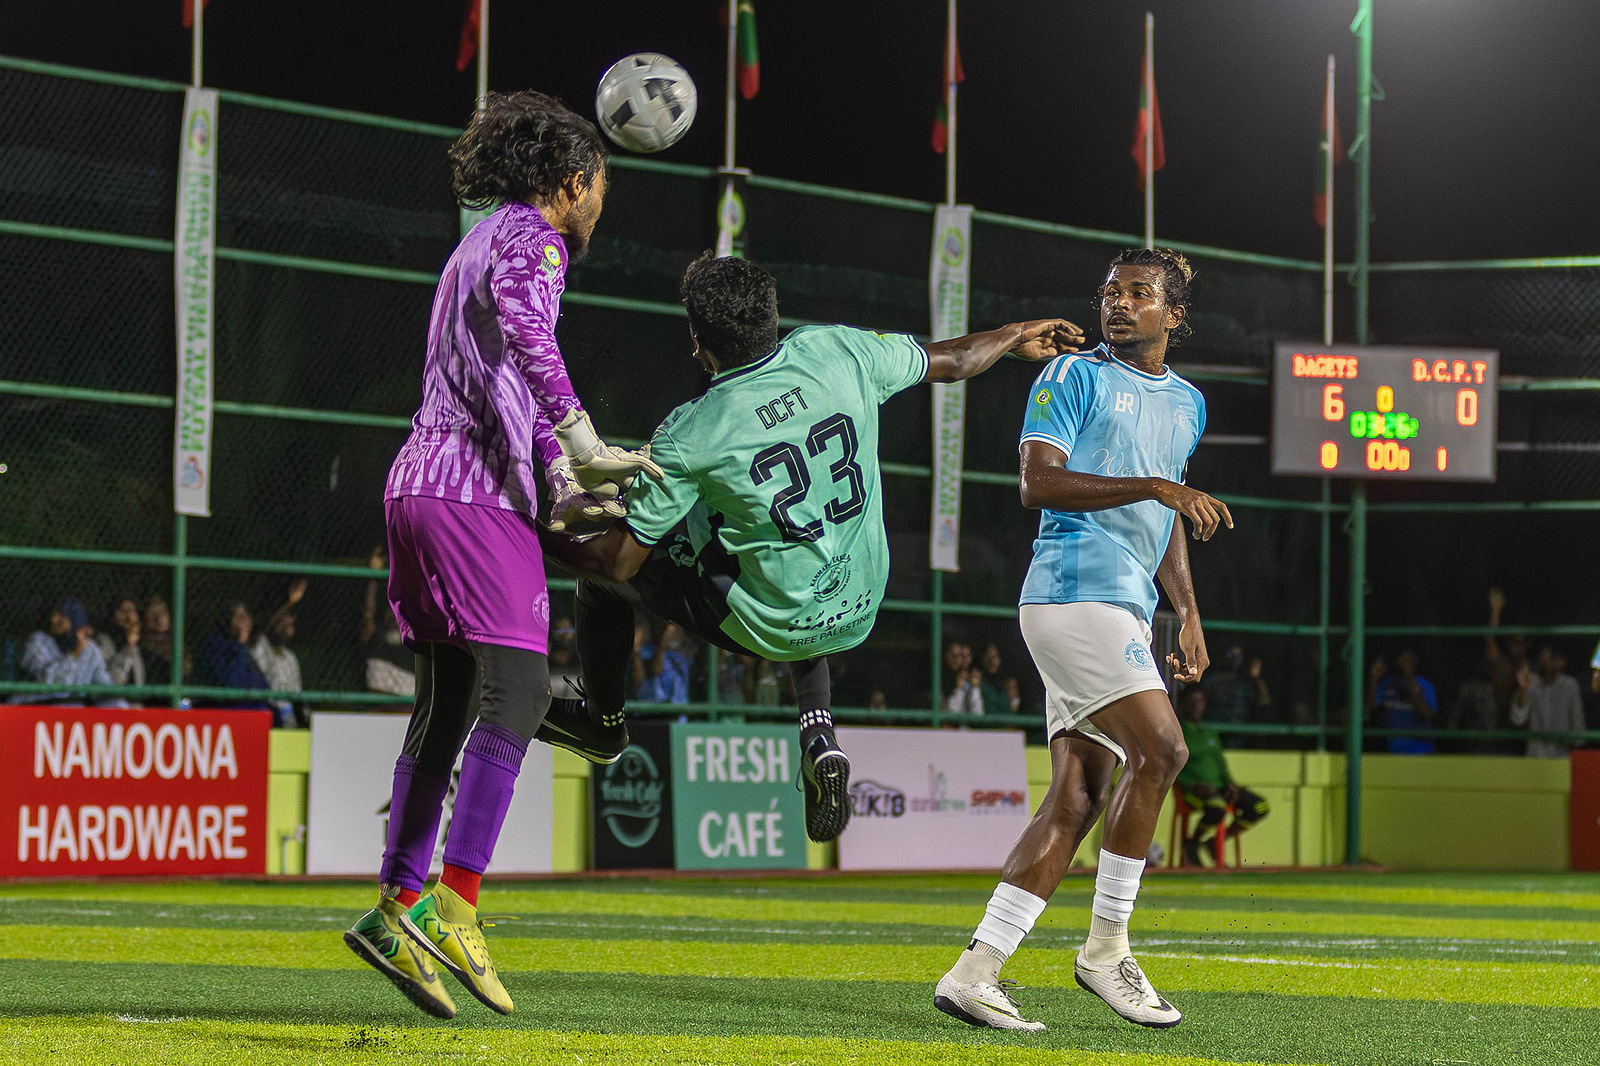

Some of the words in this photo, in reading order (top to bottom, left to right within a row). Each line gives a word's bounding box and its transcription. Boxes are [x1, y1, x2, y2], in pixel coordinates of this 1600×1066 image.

[755, 387, 809, 430] DCFT
[1322, 383, 1345, 422] 6
[1376, 385, 1394, 413] 0
[1456, 388, 1478, 426] 0
[748, 412, 867, 544] 23
[1320, 440, 1338, 470] 0
[789, 635, 818, 647] FREE
[820, 611, 874, 641] PALESTINE
[34, 721, 239, 780] NAMOONA
[685, 736, 790, 784] FRESH
[17, 804, 248, 862] HARDWARE
[697, 797, 785, 859] CAFÉ
